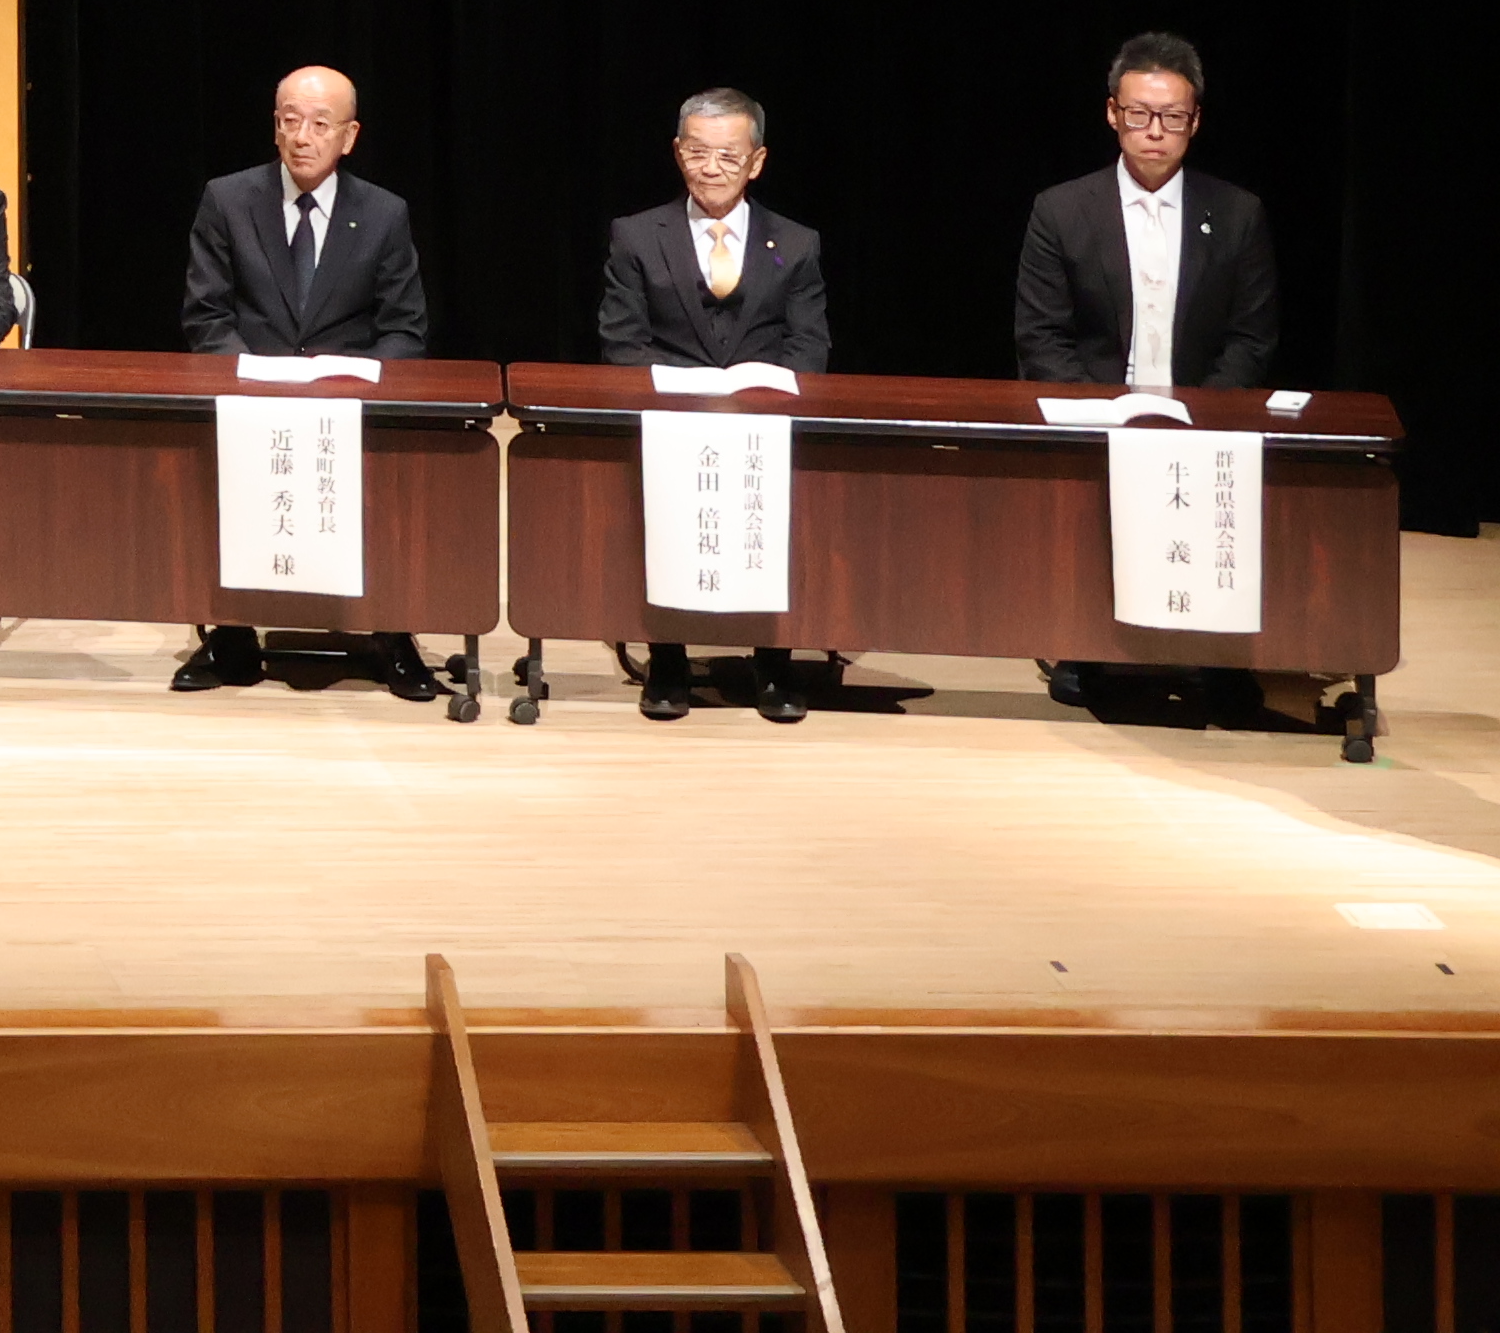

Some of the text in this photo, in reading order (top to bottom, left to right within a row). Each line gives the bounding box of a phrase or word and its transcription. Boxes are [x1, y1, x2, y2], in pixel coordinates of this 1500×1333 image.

[269, 428, 296, 576] 近藤 秀夫 様
[316, 416, 337, 534] 甘楽町教育長
[697, 444, 721, 592] 金田 倍視 様
[743, 432, 764, 570] 甘楽町議会議長
[1165, 461, 1191, 613] 牛木 義 様
[1214, 450, 1236, 590] 群馬県議会議員
